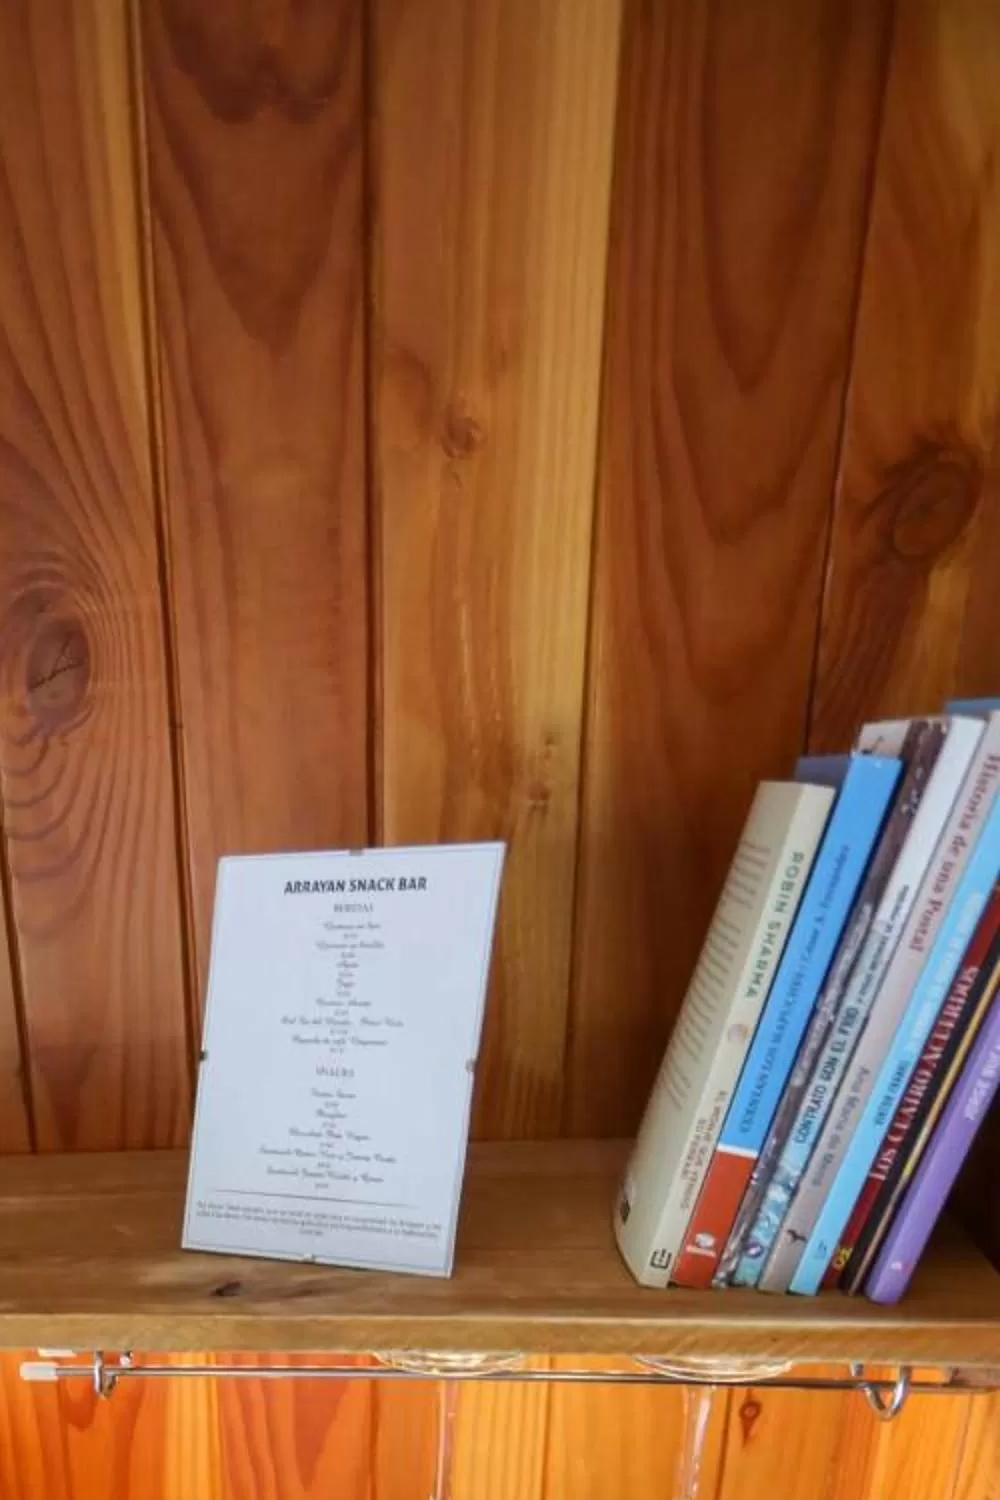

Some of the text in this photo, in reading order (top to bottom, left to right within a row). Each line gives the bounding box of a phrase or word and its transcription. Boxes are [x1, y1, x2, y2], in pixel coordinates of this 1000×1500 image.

[949, 834, 968, 855] de
[284, 876, 427, 894] ARRAYAN SNACK BAR
[932, 860, 955, 893] una
[744, 851, 804, 998] ROBIN SHARMA
[908, 899, 942, 953] Postal
[793, 1085, 826, 1144] CONTRATO
[831, 1038, 846, 1053] EL
[868, 1147, 897, 1182] LOS
[887, 1067, 933, 1142] CUATRO
[920, 965, 979, 1067] ACUERDOS
